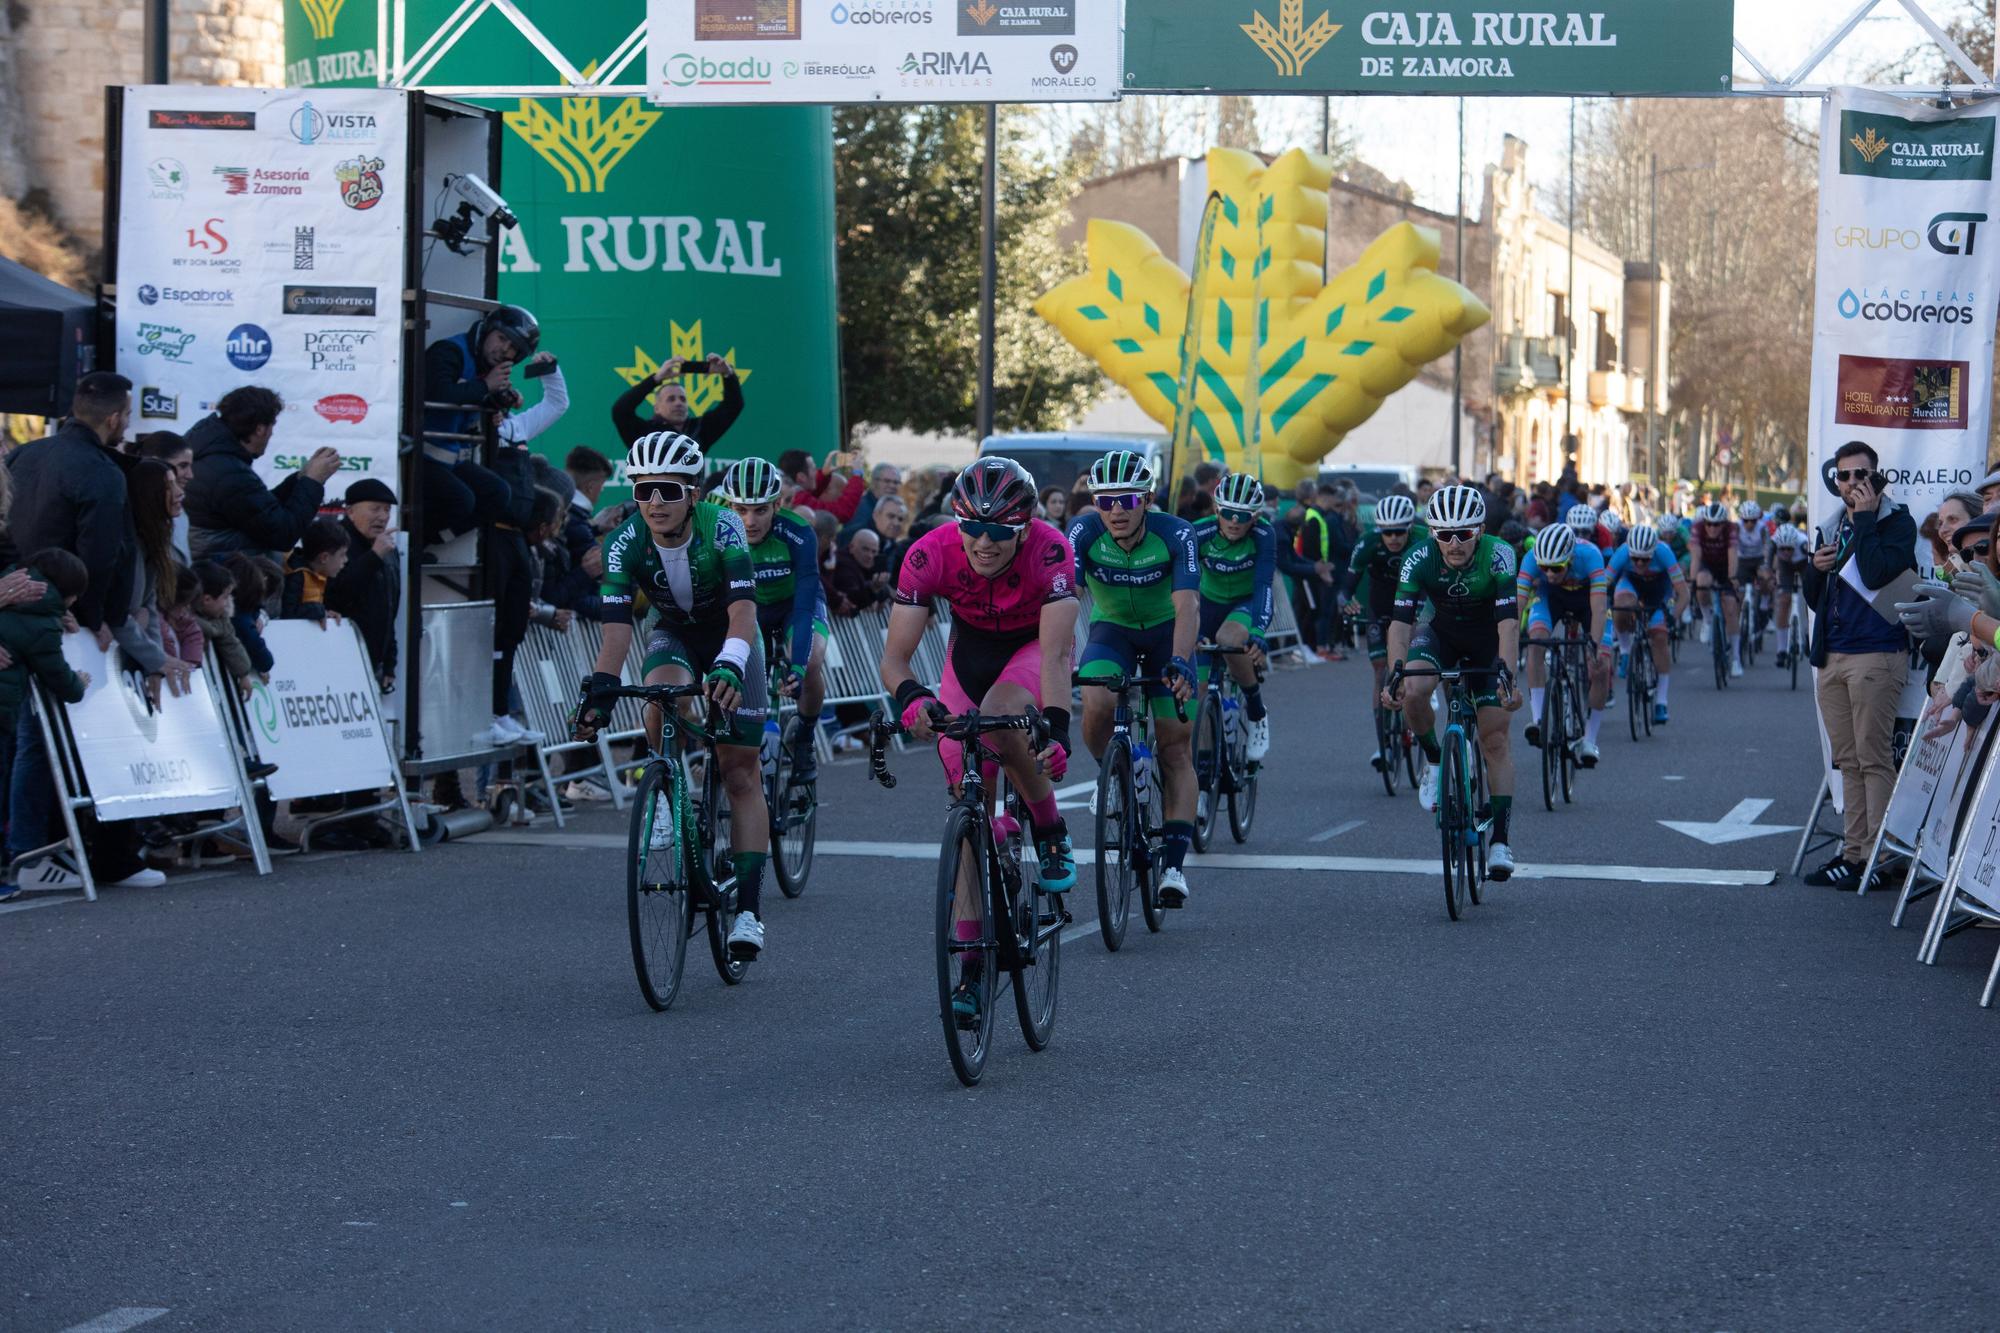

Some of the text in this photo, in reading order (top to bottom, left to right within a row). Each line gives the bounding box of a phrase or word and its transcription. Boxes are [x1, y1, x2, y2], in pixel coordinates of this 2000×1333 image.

[850, 9, 933, 24] cobreros
[1000, 7, 1067, 17] CAJA RURAL
[1361, 12, 1617, 47] CAJA RURAL
[804, 64, 876, 75] IBEREÓLICA
[1360, 57, 1514, 77] DE ZAMORA
[901, 78, 993, 88] SEMILLAS
[1032, 77, 1096, 87] MORALEJO
[327, 115, 376, 128] VISTA
[327, 129, 376, 139] ALEGRE
[1891, 142, 1984, 156] CAJA RURAL
[1891, 158, 1946, 167] DE ZAMORA
[253, 167, 310, 181] Asesoría
[253, 182, 303, 195] Zamora
[1835, 226, 1921, 250] GRUPO
[561, 216, 781, 277] RURAL
[162, 287, 233, 302] Espabrok
[335, 296, 373, 306] ÓPTICO
[1863, 286, 1974, 302] LÁCTEAS
[1862, 300, 1973, 324] cobreros
[304, 332, 353, 352] Puente
[311, 352, 356, 370] Piedra
[1845, 391, 1873, 402] HOTEL
[1844, 402, 1910, 417] RESTAURANTE
[1187, 540, 1197, 572] CORTIZO
[1400, 545, 1428, 584] RENFLOW
[1113, 571, 1162, 584] CORTIZO
[280, 685, 374, 728] IBEREÓLICA
[129, 759, 191, 786] MORALEJO
